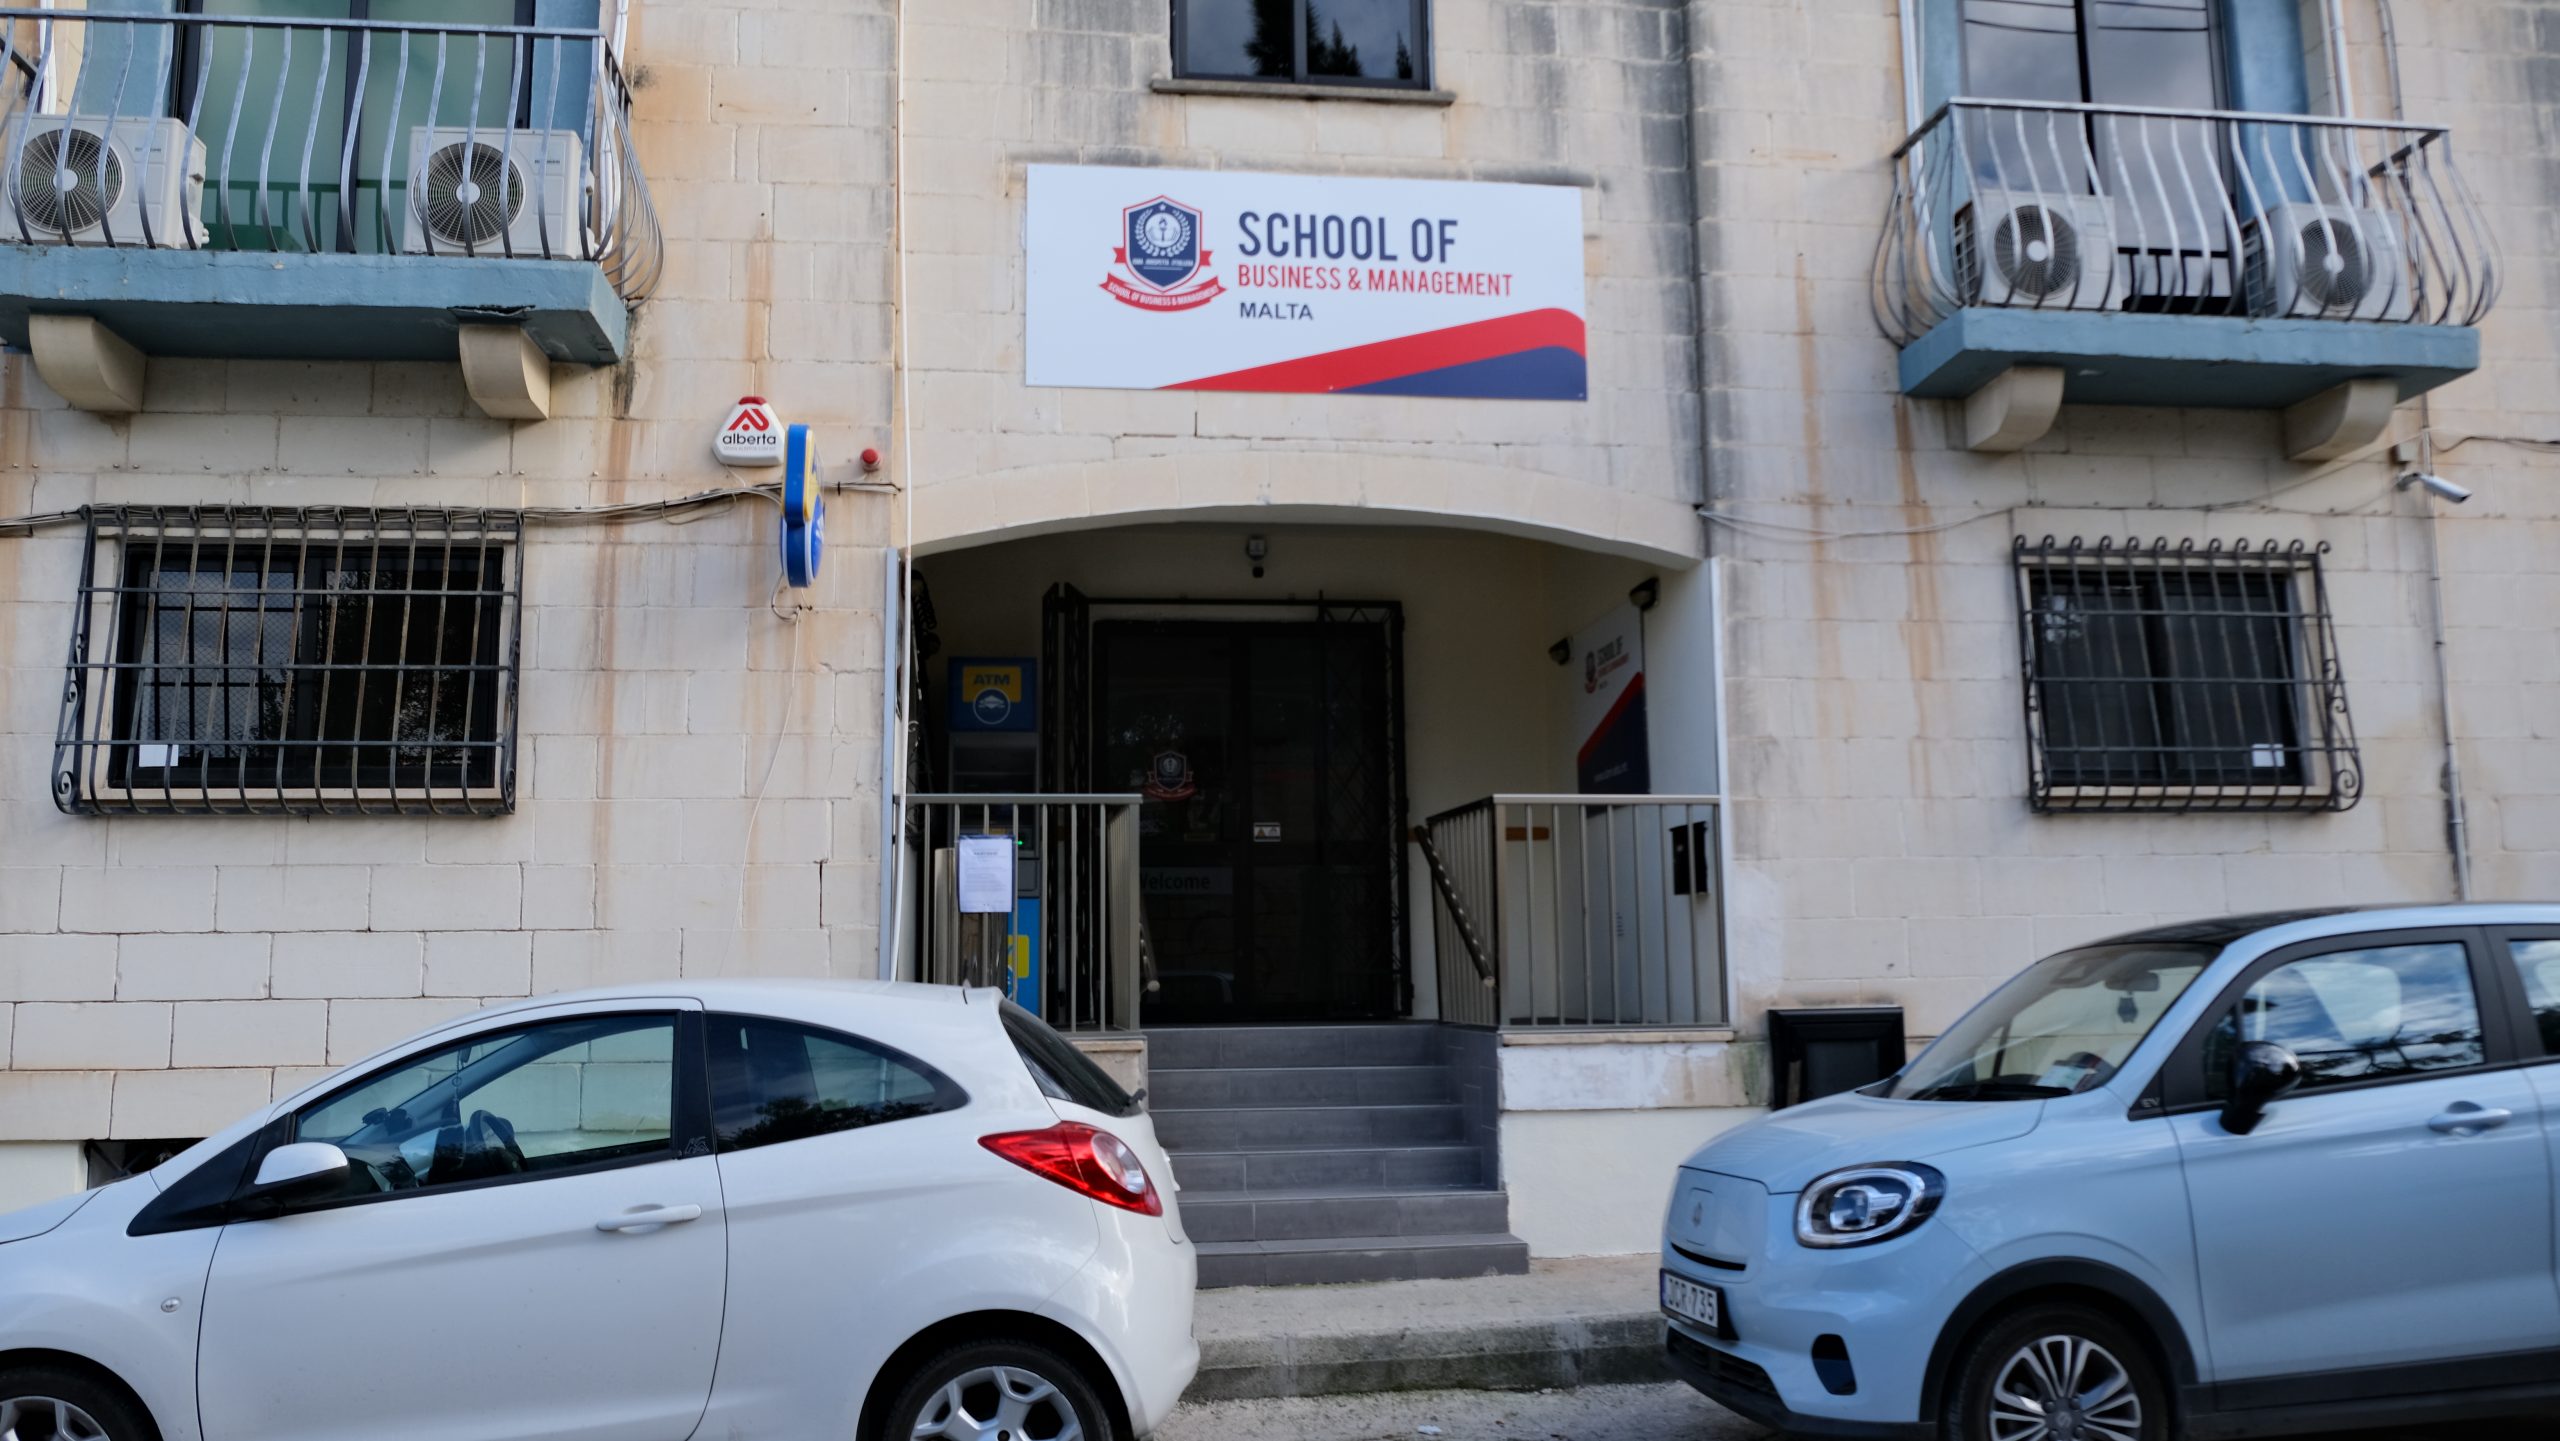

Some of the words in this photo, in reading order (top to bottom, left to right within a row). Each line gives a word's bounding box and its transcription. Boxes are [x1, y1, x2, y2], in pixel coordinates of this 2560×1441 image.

[1238, 211, 1398, 261] SCHOOL
[1411, 218, 1458, 264] OF
[1238, 264, 1341, 290] BUSINESS
[1348, 267, 1361, 290] &
[1368, 269, 1513, 297] MANAGEMENT
[1107, 282, 1131, 299] SCHOOL
[1240, 302, 1314, 320] MALTA
[722, 433, 776, 445] alberta
[973, 674, 1010, 685] ATM
[1691, 1286, 1715, 1321] 735
